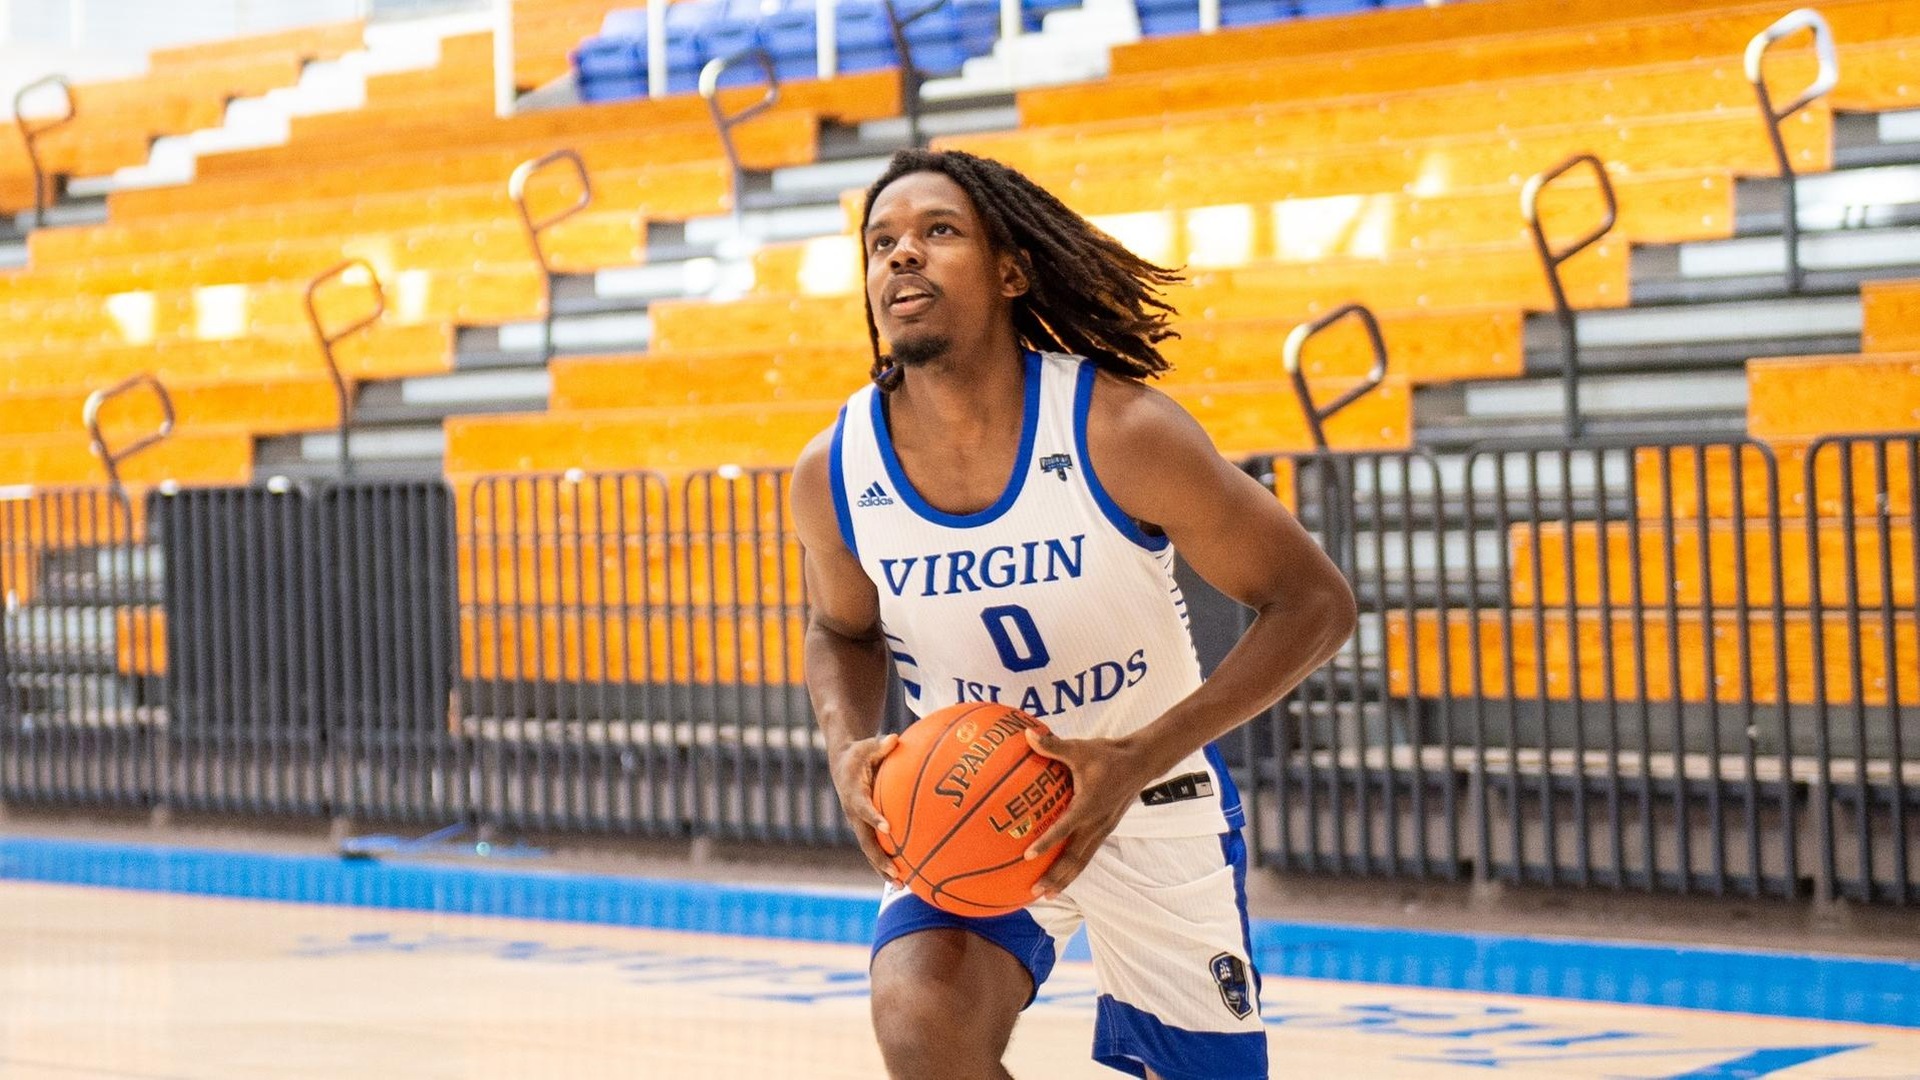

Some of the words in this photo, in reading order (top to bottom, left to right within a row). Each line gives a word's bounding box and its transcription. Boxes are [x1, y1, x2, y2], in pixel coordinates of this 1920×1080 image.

[857, 496, 894, 508] adidas
[879, 534, 1086, 597] VIRGIN
[980, 603, 1051, 673] 0
[934, 710, 1038, 809] SPALDING
[989, 760, 1065, 833] LEGAC
